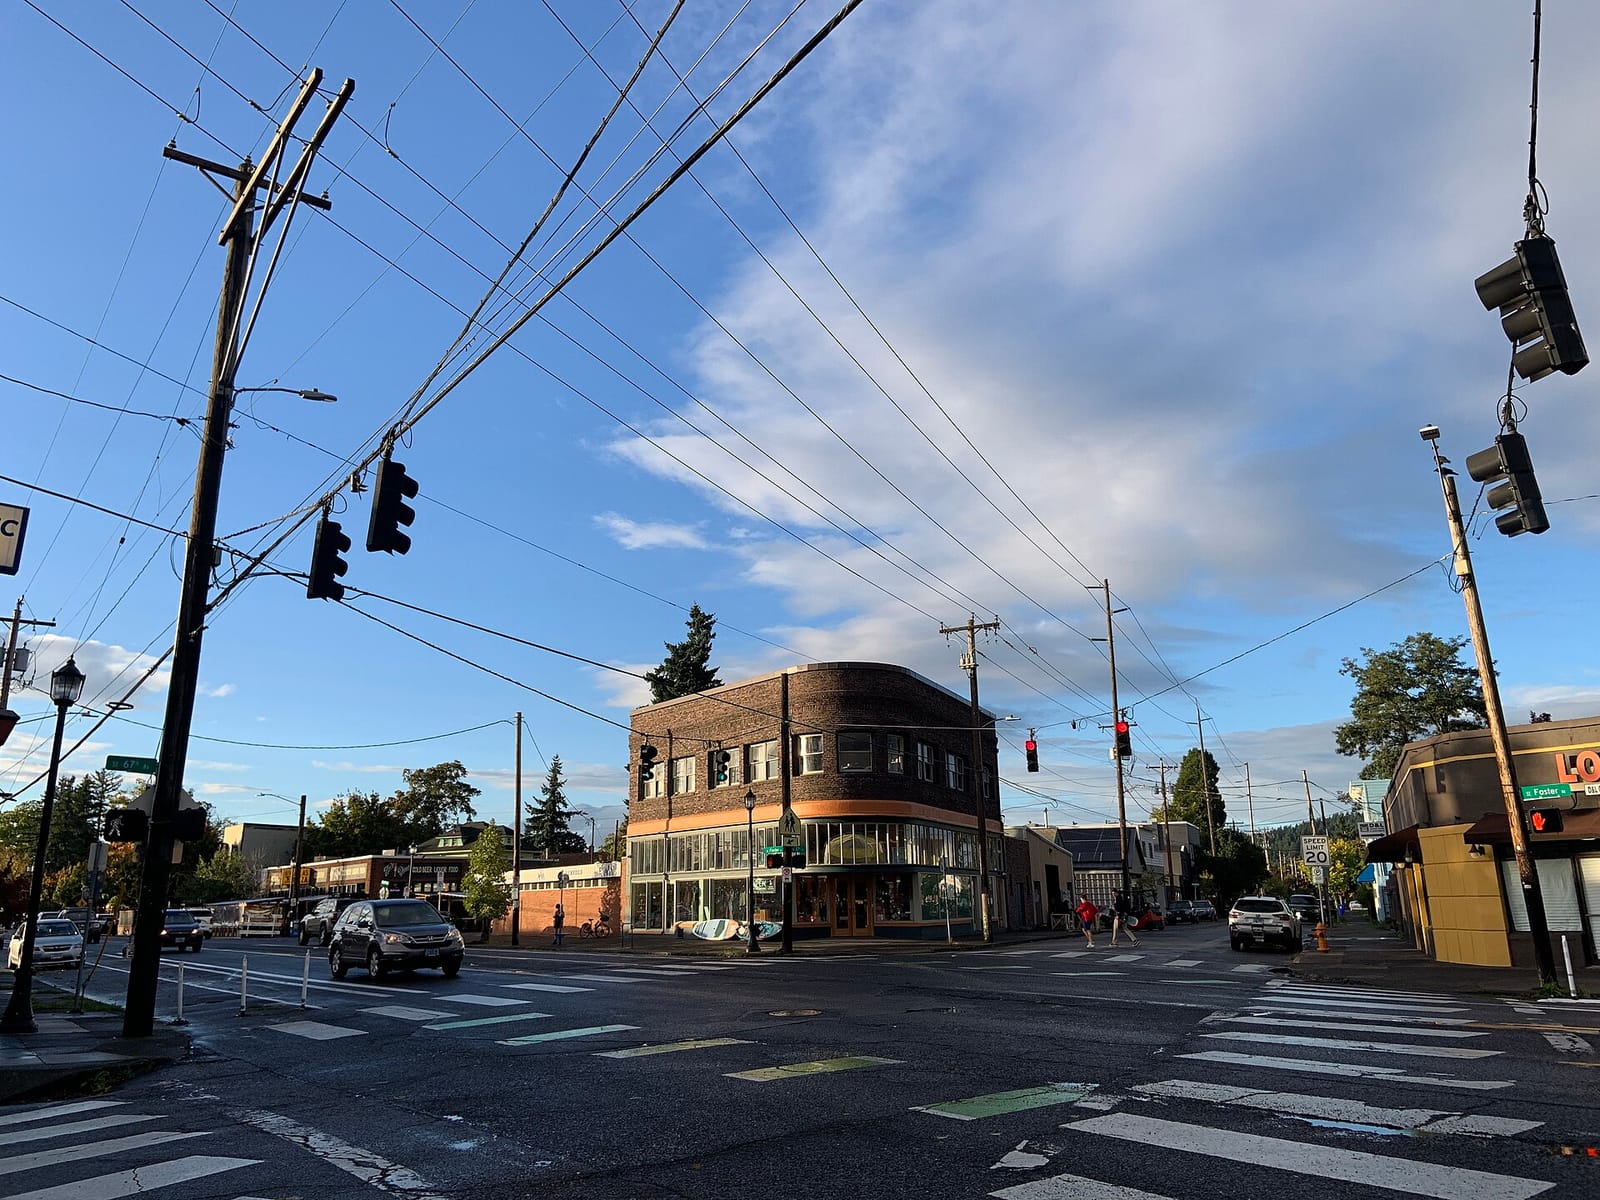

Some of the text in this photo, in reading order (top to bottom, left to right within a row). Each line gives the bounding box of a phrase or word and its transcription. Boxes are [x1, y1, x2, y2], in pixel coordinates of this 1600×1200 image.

[0, 518, 19, 537] C
[1533, 788, 1559, 796] Foster
[1305, 851, 1328, 863] 20
